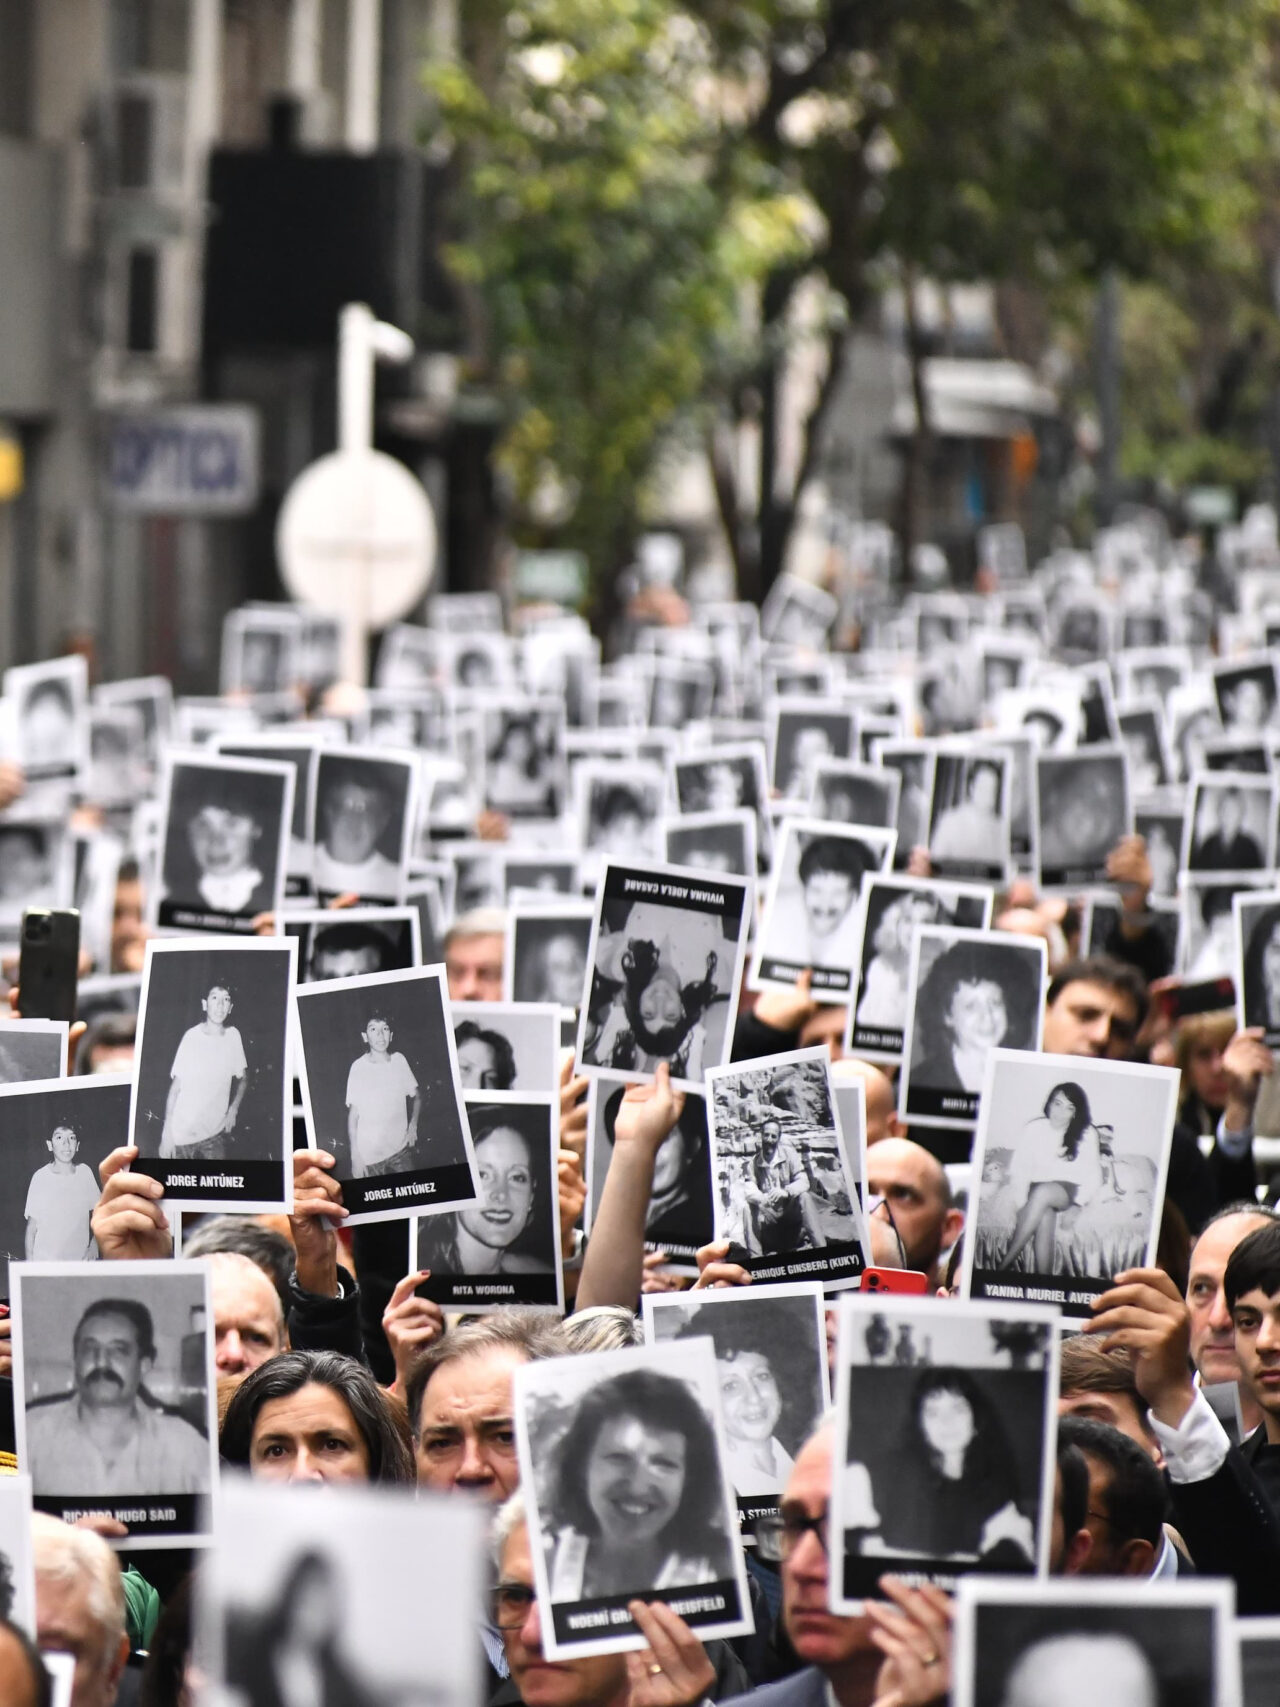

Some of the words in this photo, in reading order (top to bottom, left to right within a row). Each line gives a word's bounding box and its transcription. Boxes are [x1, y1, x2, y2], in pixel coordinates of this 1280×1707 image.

[661, 884, 689, 898] ADELA
[690, 889, 725, 904] VIVIANA
[166, 1175, 197, 1188] JORGE
[200, 1173, 244, 1188] ANTÚNEZ
[363, 1188, 393, 1202] JORGE
[395, 1182, 437, 1198] ANTÚNEZ
[657, 1242, 697, 1257] GUTERMA
[750, 1266, 787, 1281] ENRIQUE
[787, 1258, 829, 1275] GINSBERG
[829, 1254, 860, 1271] (KUKY)
[453, 1285, 474, 1296] RITA
[476, 1285, 515, 1295] WORONA
[985, 1284, 1024, 1299] YANINA
[1026, 1288, 1067, 1303] MURIEL
[115, 1510, 147, 1522] HUGO
[149, 1509, 177, 1521] SAID
[569, 1608, 609, 1629] NOEMÍ
